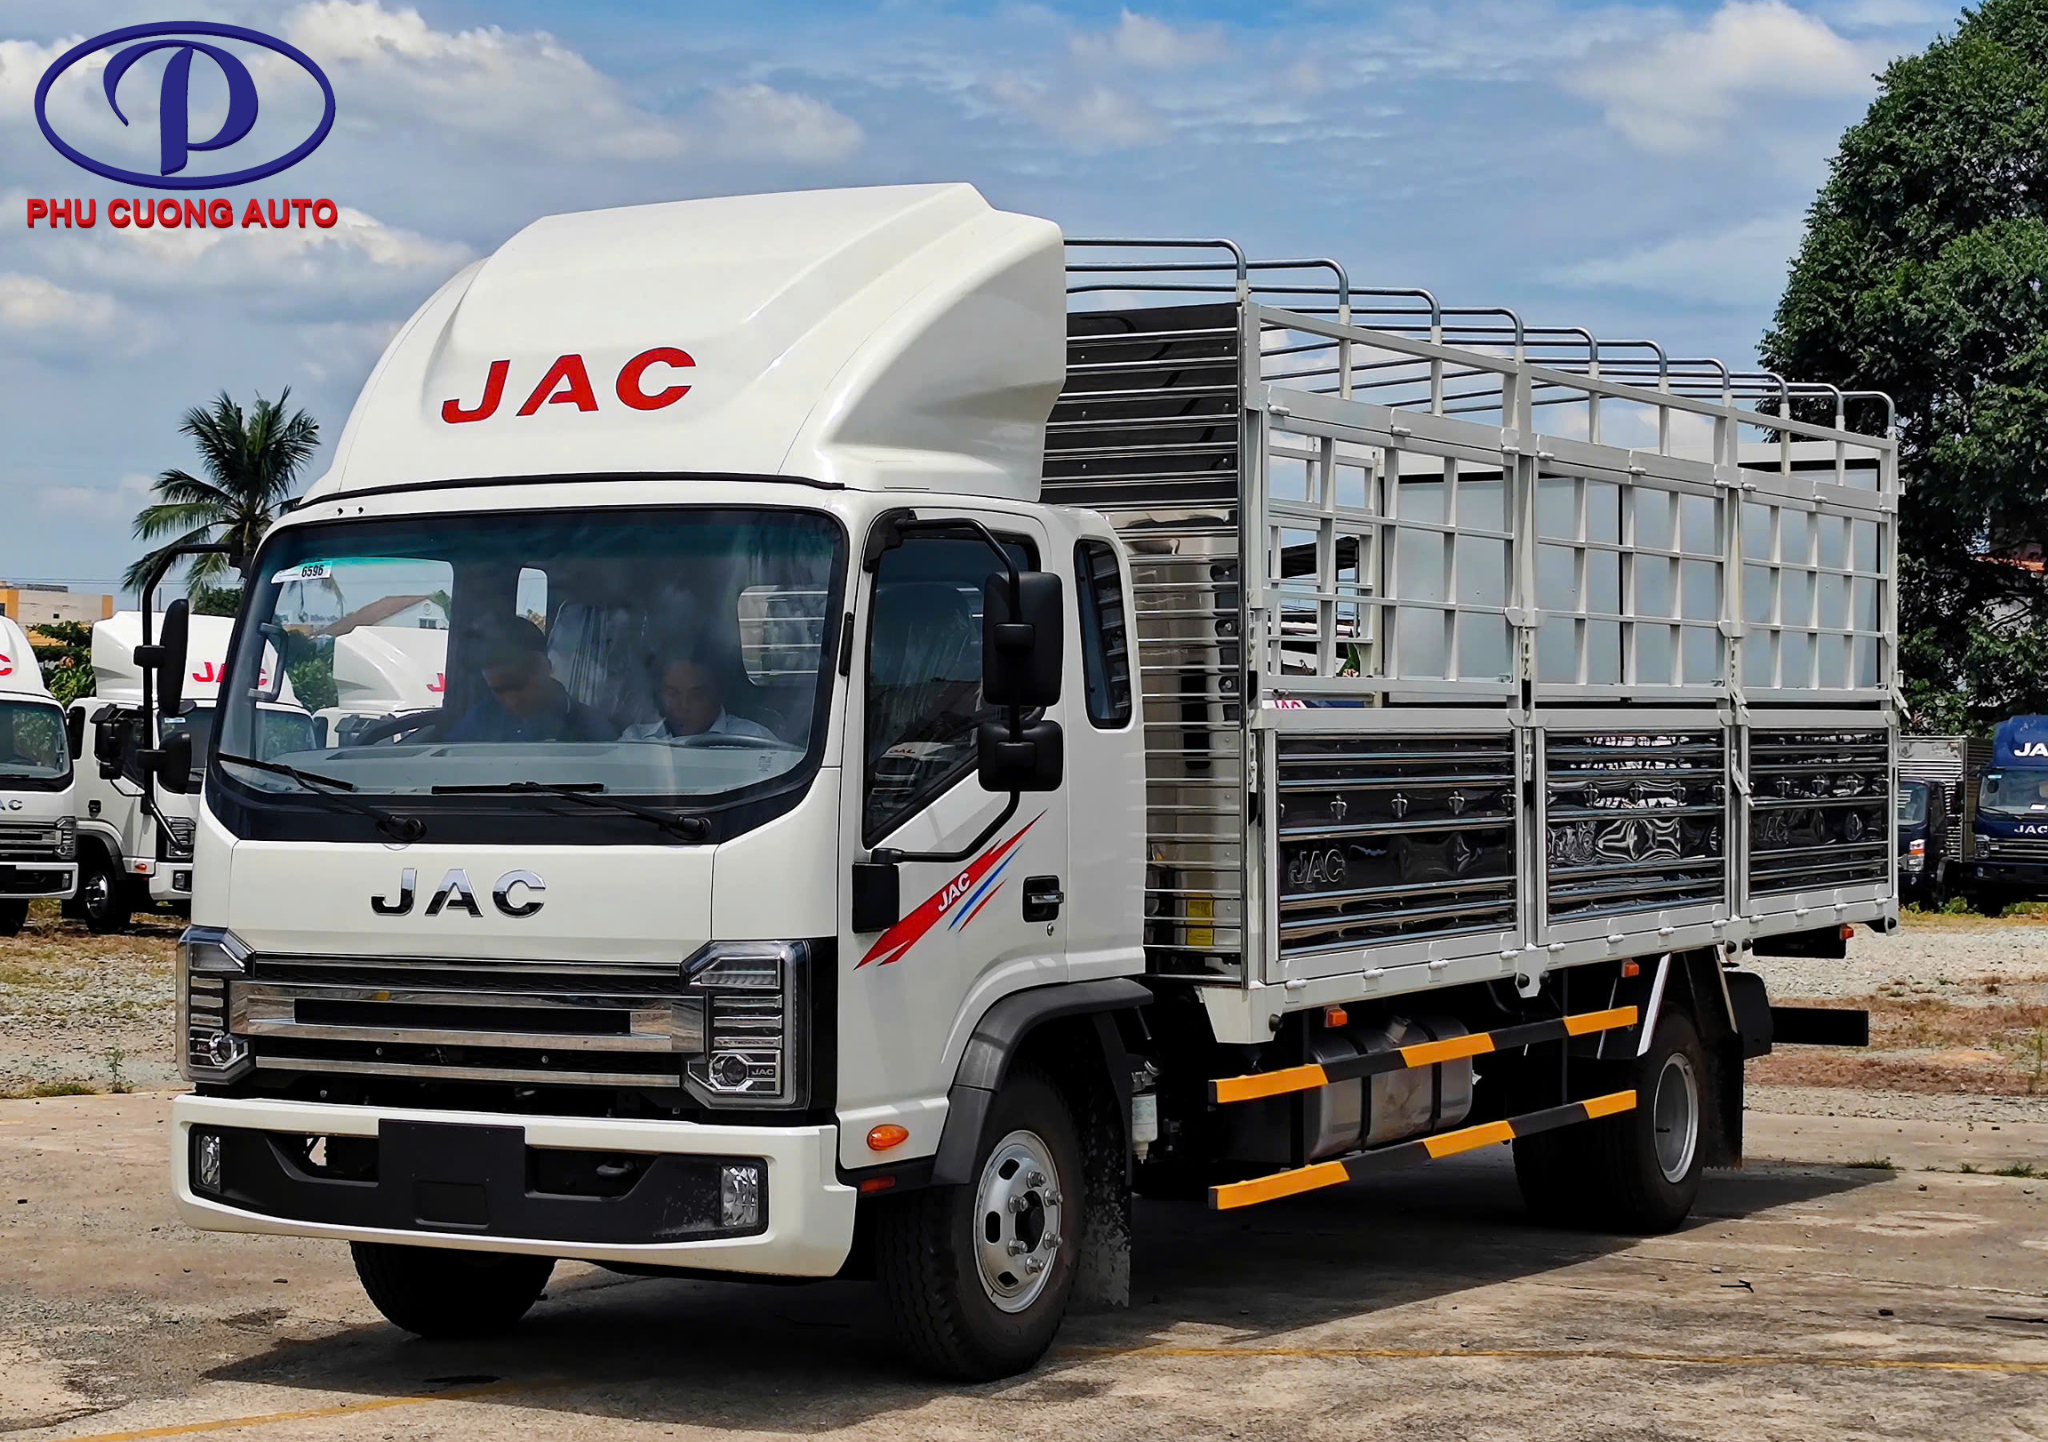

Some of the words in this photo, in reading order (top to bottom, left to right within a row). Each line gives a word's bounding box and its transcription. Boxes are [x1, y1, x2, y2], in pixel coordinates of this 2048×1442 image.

[441, 347, 696, 424] JAC
[301, 565, 325, 578] 6596
[1288, 848, 1347, 885] JAC
[371, 867, 547, 918] JAC
[937, 872, 970, 912] JAC
[751, 1068, 775, 1076] JAC
